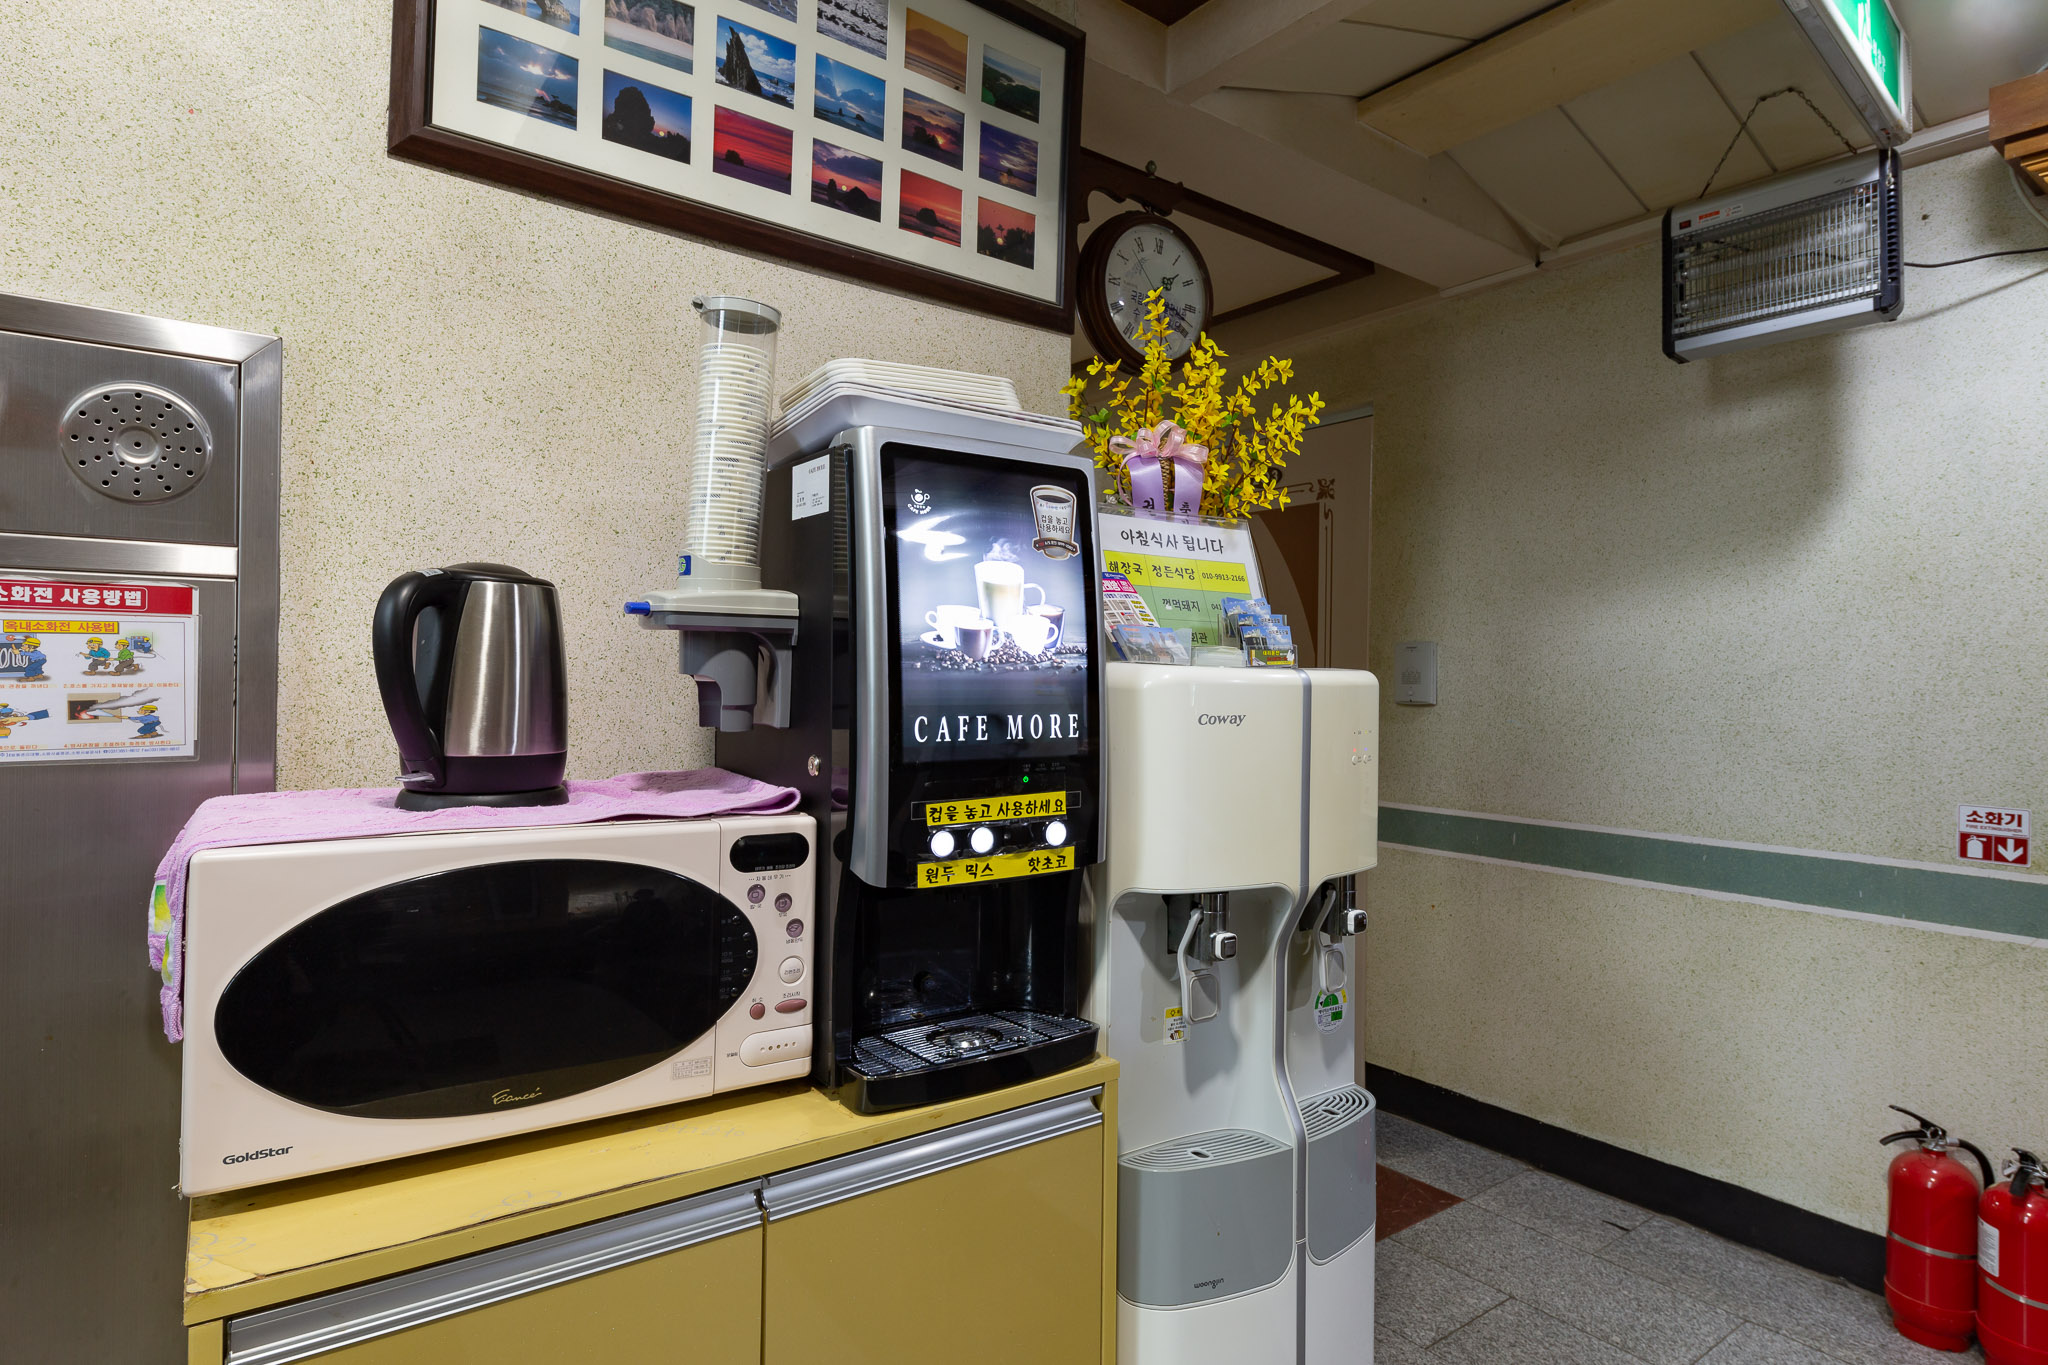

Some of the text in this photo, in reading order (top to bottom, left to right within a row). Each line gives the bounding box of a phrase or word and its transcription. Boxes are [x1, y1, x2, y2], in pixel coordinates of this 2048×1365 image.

[1120, 529, 1224, 555] 아침식사 됩니다
[1108, 560, 1143, 576] 해장국
[1152, 564, 1195, 581] 정든식당
[60, 588, 142, 607] 사용방법
[5, 620, 115, 632] 옥내소화전 사용법
[914, 713, 1080, 743] CAFE MORE
[1197, 713, 1247, 727] Coway
[929, 798, 1066, 824] 컵을 놓고 사용하세요
[1966, 810, 2022, 828] 소화기
[925, 855, 1069, 886] 원두 믹스 핫초코
[222, 1145, 294, 1165] GoldStar
[1193, 1277, 1225, 1290] woongjin
